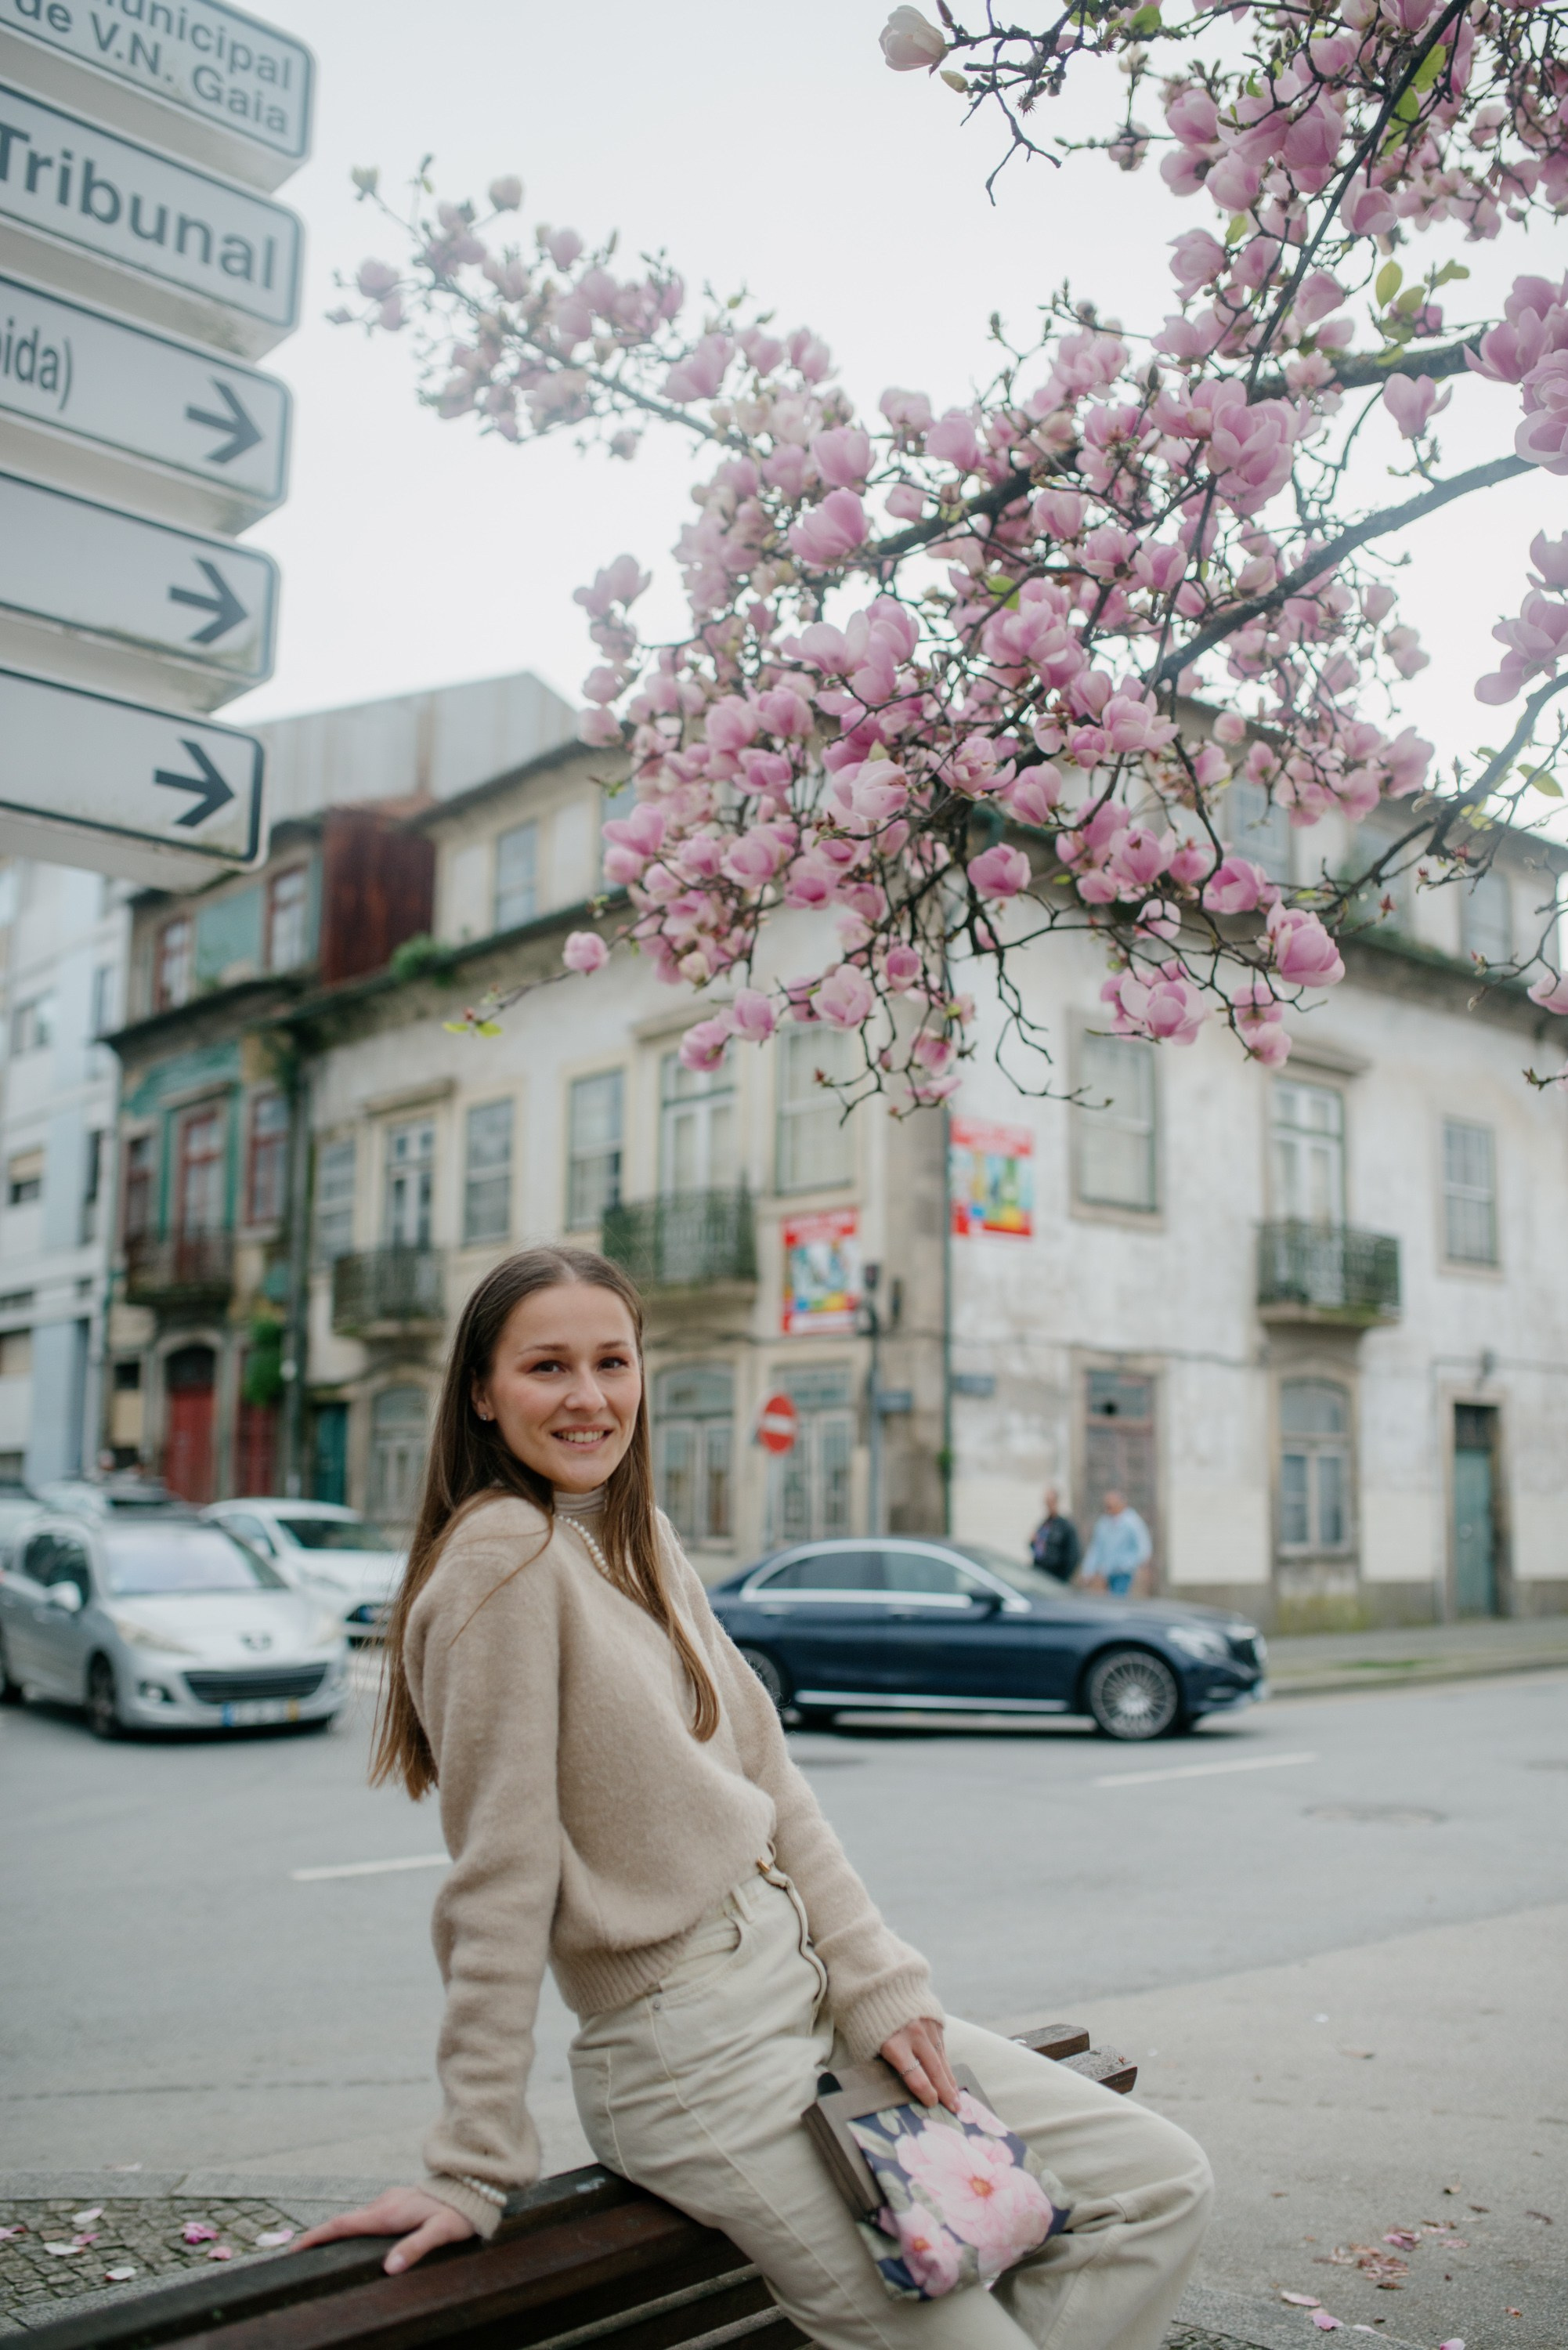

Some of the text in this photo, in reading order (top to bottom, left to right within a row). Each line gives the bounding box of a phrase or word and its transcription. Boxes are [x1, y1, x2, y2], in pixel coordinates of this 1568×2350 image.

[90, 10, 173, 82] V.N.
[193, 65, 289, 136] Gaia
[96, 0, 293, 90] unicipal
[0, 121, 276, 290] Tribunal
[0, 316, 73, 411] ida)
